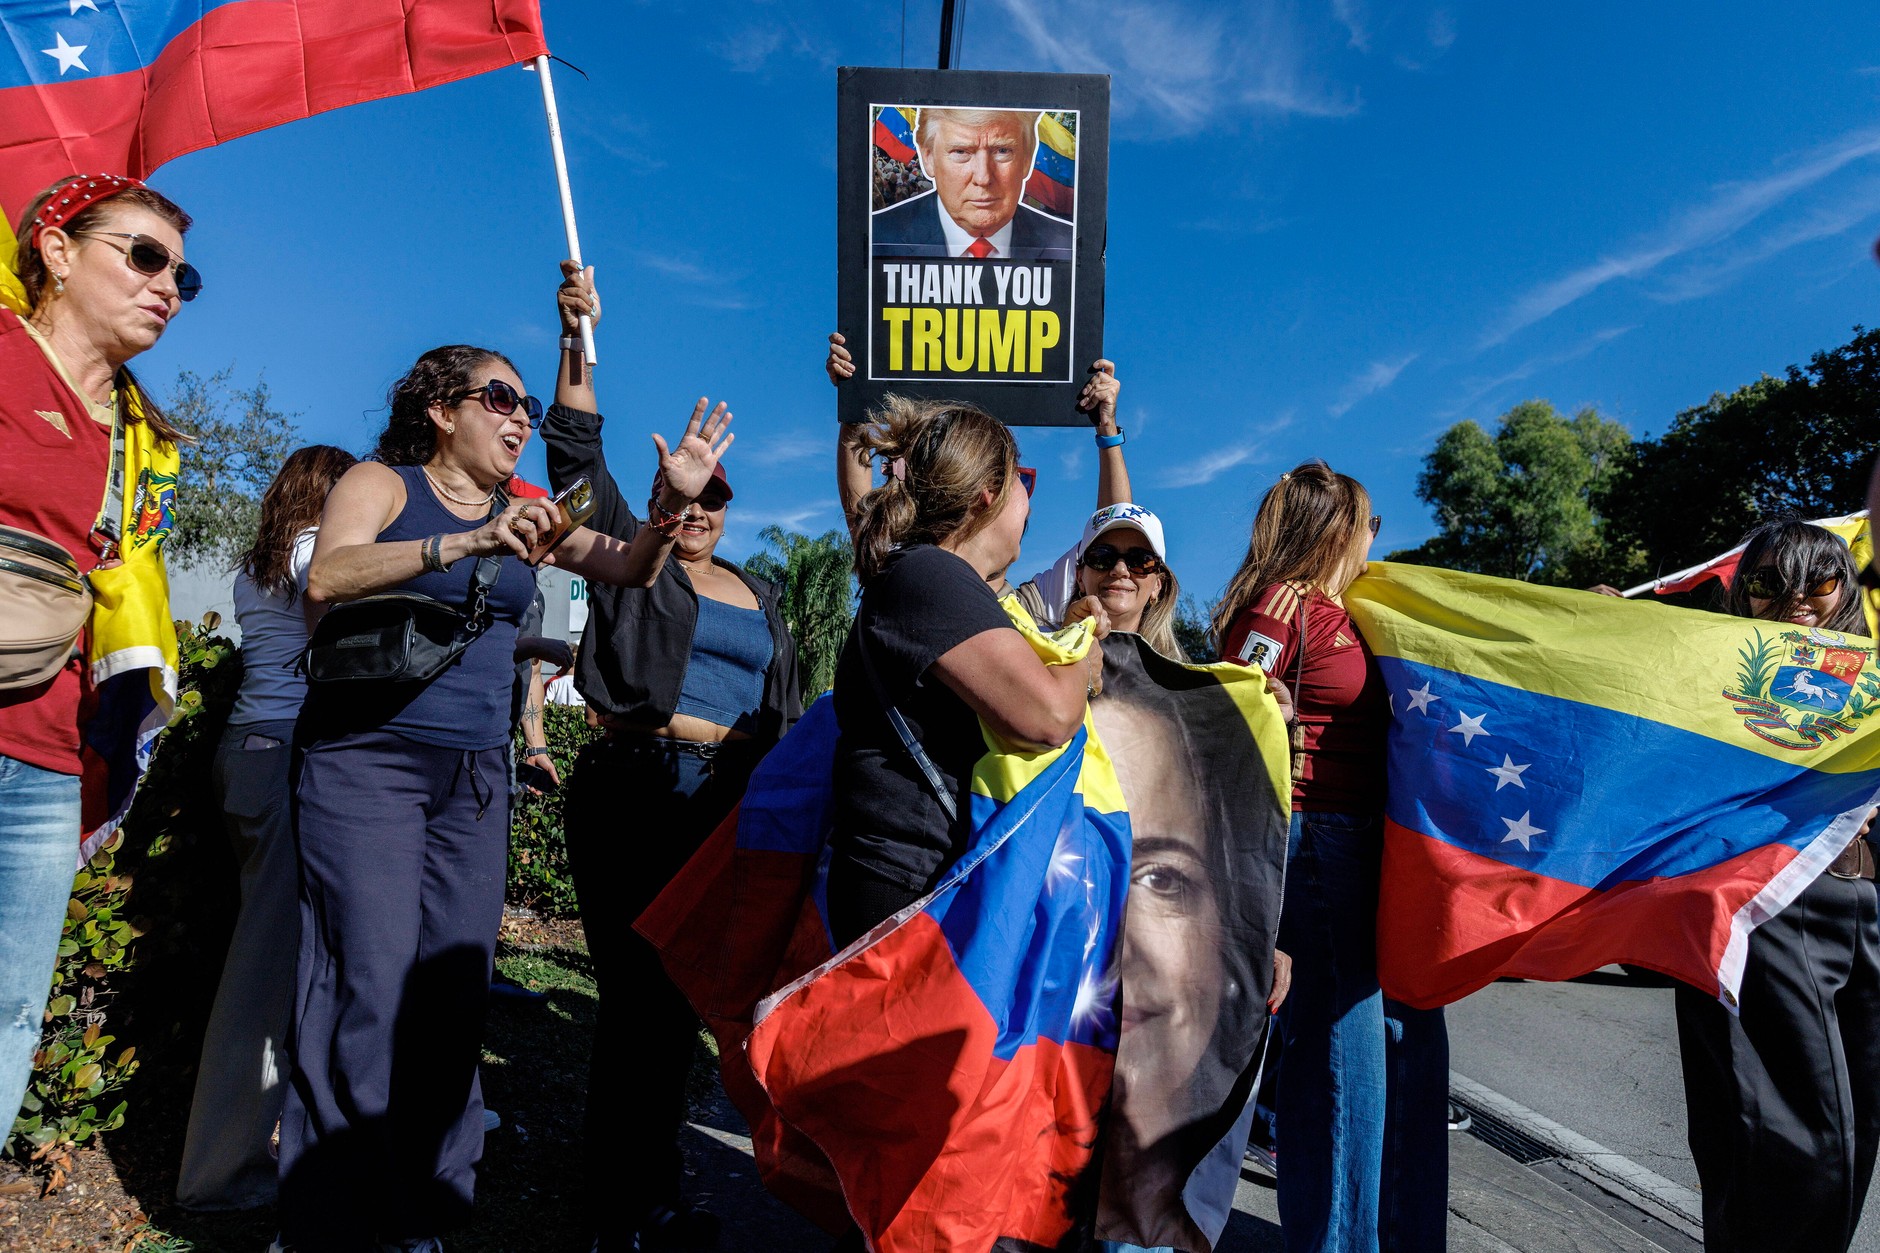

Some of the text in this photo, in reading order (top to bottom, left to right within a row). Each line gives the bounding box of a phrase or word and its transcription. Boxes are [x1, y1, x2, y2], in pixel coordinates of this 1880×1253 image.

[883, 264, 1052, 306] THANK YOU
[882, 307, 1061, 373] TRUMP
[571, 579, 589, 601] DI
